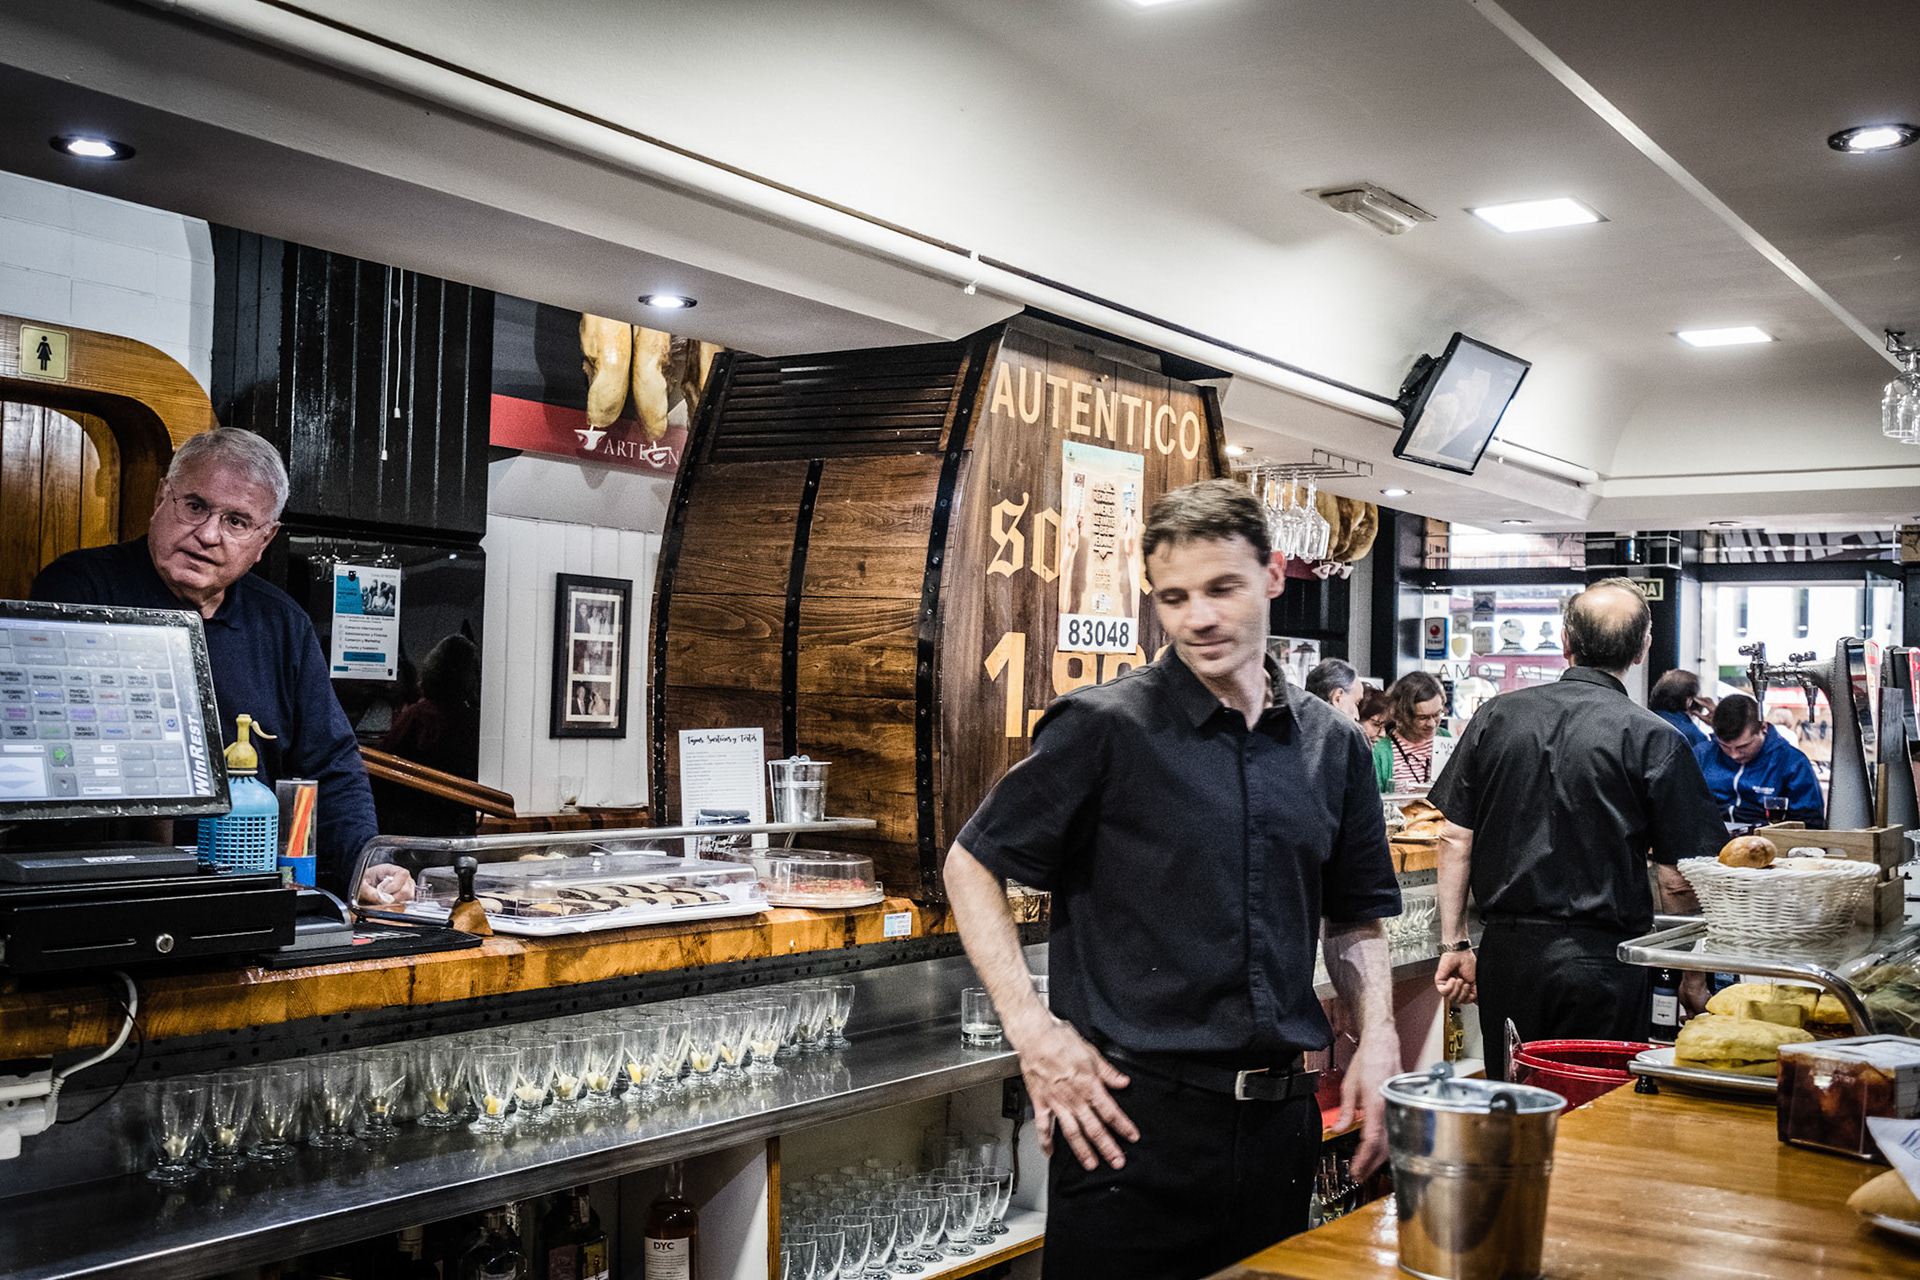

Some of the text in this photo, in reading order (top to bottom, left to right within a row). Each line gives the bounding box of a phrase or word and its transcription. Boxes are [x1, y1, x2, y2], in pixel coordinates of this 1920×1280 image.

[990, 361, 1201, 460] AUTENTICO
[1068, 619, 1129, 648] 83048
[653, 1241, 675, 1251] DYC
